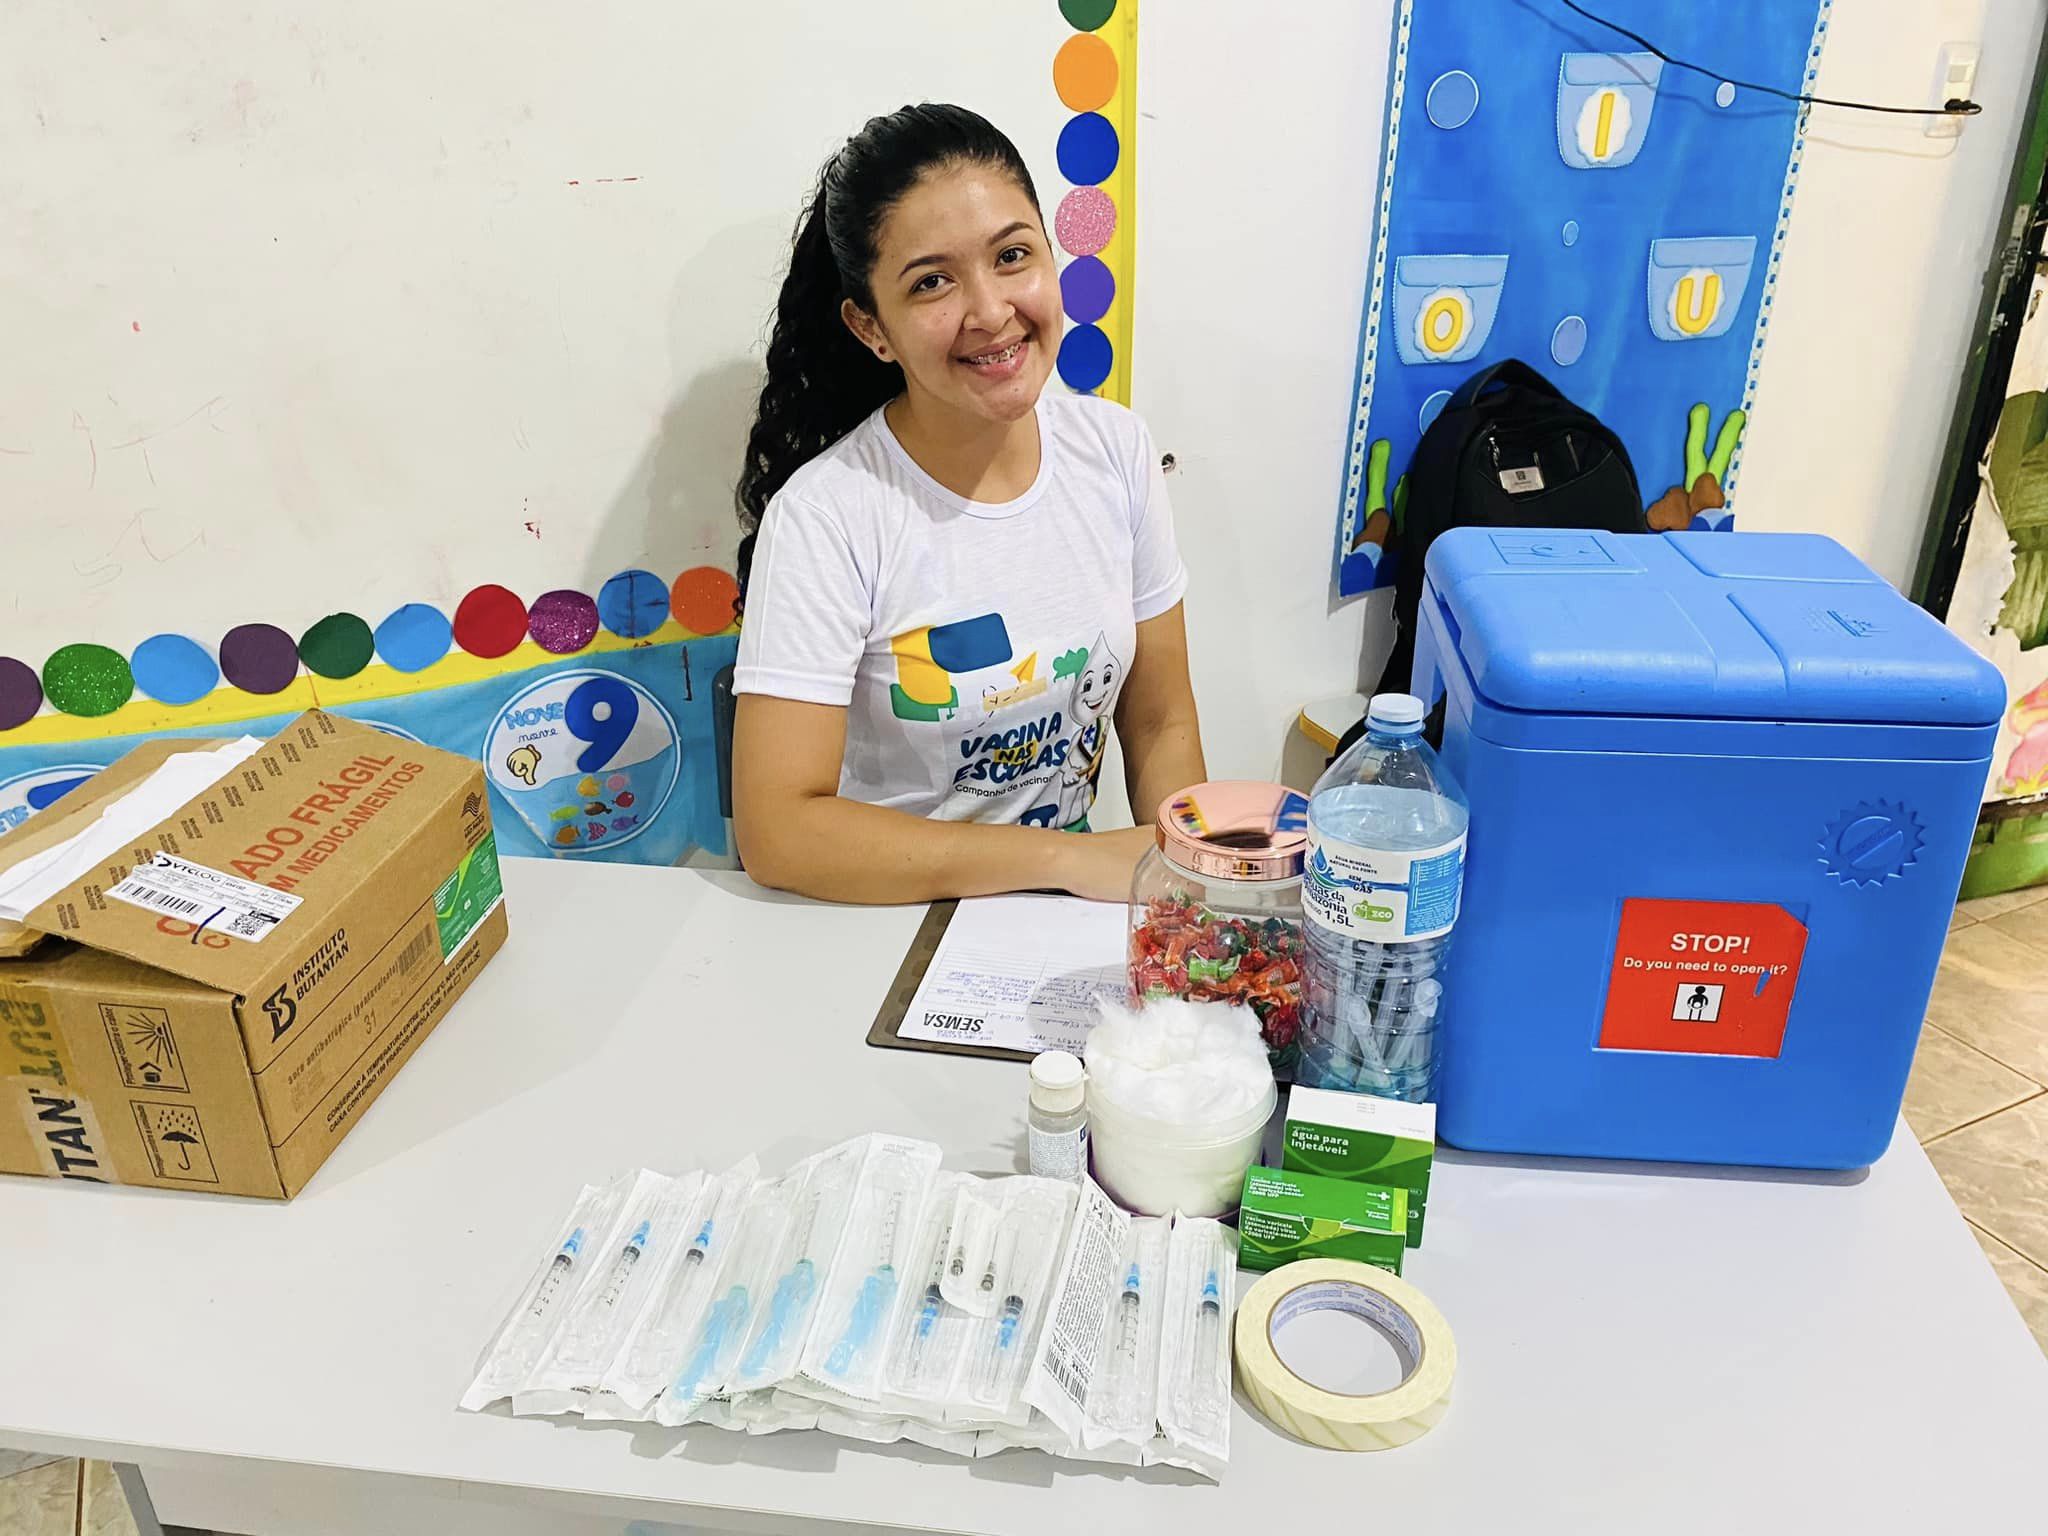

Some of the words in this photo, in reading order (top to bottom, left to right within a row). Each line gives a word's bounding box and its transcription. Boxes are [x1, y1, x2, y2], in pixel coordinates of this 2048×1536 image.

[1594, 92, 1615, 158] I
[1423, 296, 1464, 354] O
[1675, 273, 1721, 335] U
[503, 701, 565, 731] NOVE
[517, 727, 559, 744] nove
[564, 676, 640, 774] 9
[960, 711, 1063, 759] VACINA
[953, 738, 1070, 786] ESCOLAS
[998, 741, 1034, 763] NAS
[288, 754, 396, 827] FRÁGIL
[954, 784, 1007, 798] Campanha
[1006, 783, 1018, 793] de
[300, 761, 425, 876] MEDICAMENTOS
[171, 861, 222, 884] VTCLOG
[1331, 890, 1345, 903] da
[292, 927, 346, 986] INSTITUTO
[1623, 957, 1644, 969] Do
[1645, 959, 1673, 971] you
[1675, 961, 1710, 972] need
[1712, 962, 1728, 973] to
[1730, 965, 1766, 976] open
[1769, 964, 1789, 976] it?
[1670, 932, 1751, 955] STOP!
[295, 940, 350, 1002] BUTANTAN
[921, 1011, 985, 1034] SEMSA
[326, 1078, 362, 1123] CONSERVAR
[366, 1030, 405, 1079] TEMPERATURA
[328, 1109, 350, 1134] CAIXA
[346, 1075, 379, 1115] CONTENDO
[1290, 1137, 1349, 1157] injetáveis
[1291, 1129, 1321, 1143] água
[1322, 1135, 1350, 1147] para
